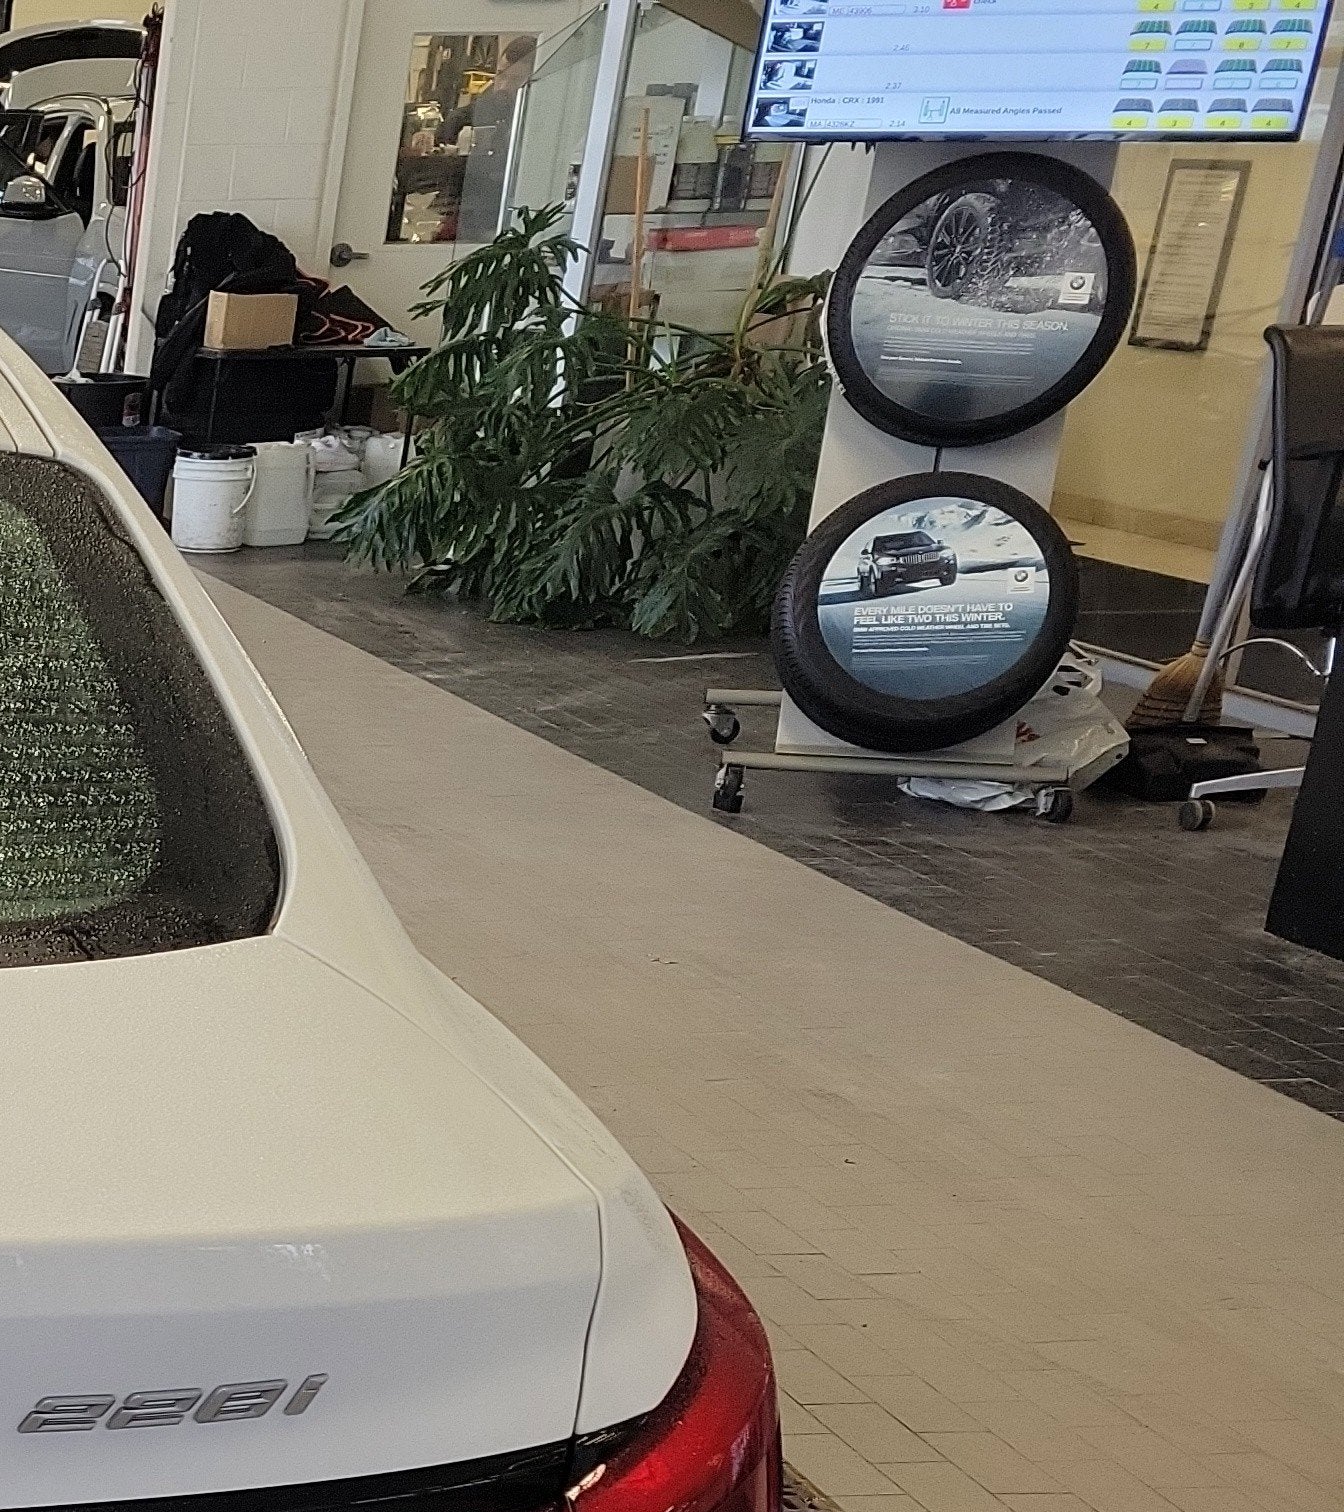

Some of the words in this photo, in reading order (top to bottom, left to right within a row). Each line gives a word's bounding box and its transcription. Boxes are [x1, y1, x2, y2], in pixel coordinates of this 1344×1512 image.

[1003, 107, 1030, 116] Angles
[1032, 106, 1062, 114] Passed
[889, 312, 919, 324] STICK
[921, 314, 932, 324] IT
[936, 315, 949, 326] TO
[952, 316, 992, 328] WINTER
[997, 319, 1020, 330] THIS
[1022, 319, 1068, 331] SEASON.
[854, 606, 888, 615] EVERY
[890, 605, 916, 614] MILE
[918, 604, 964, 613] DOESN'T
[967, 603, 996, 612] HAVE
[997, 602, 1013, 611] TO
[853, 615, 880, 624] FEEL
[881, 615, 905, 624] LIKE
[908, 614, 932, 623] TWO
[934, 613, 959, 622] THIS
[961, 612, 1005, 621] WINTER.
[17, 1373, 329, 1433] 228i
